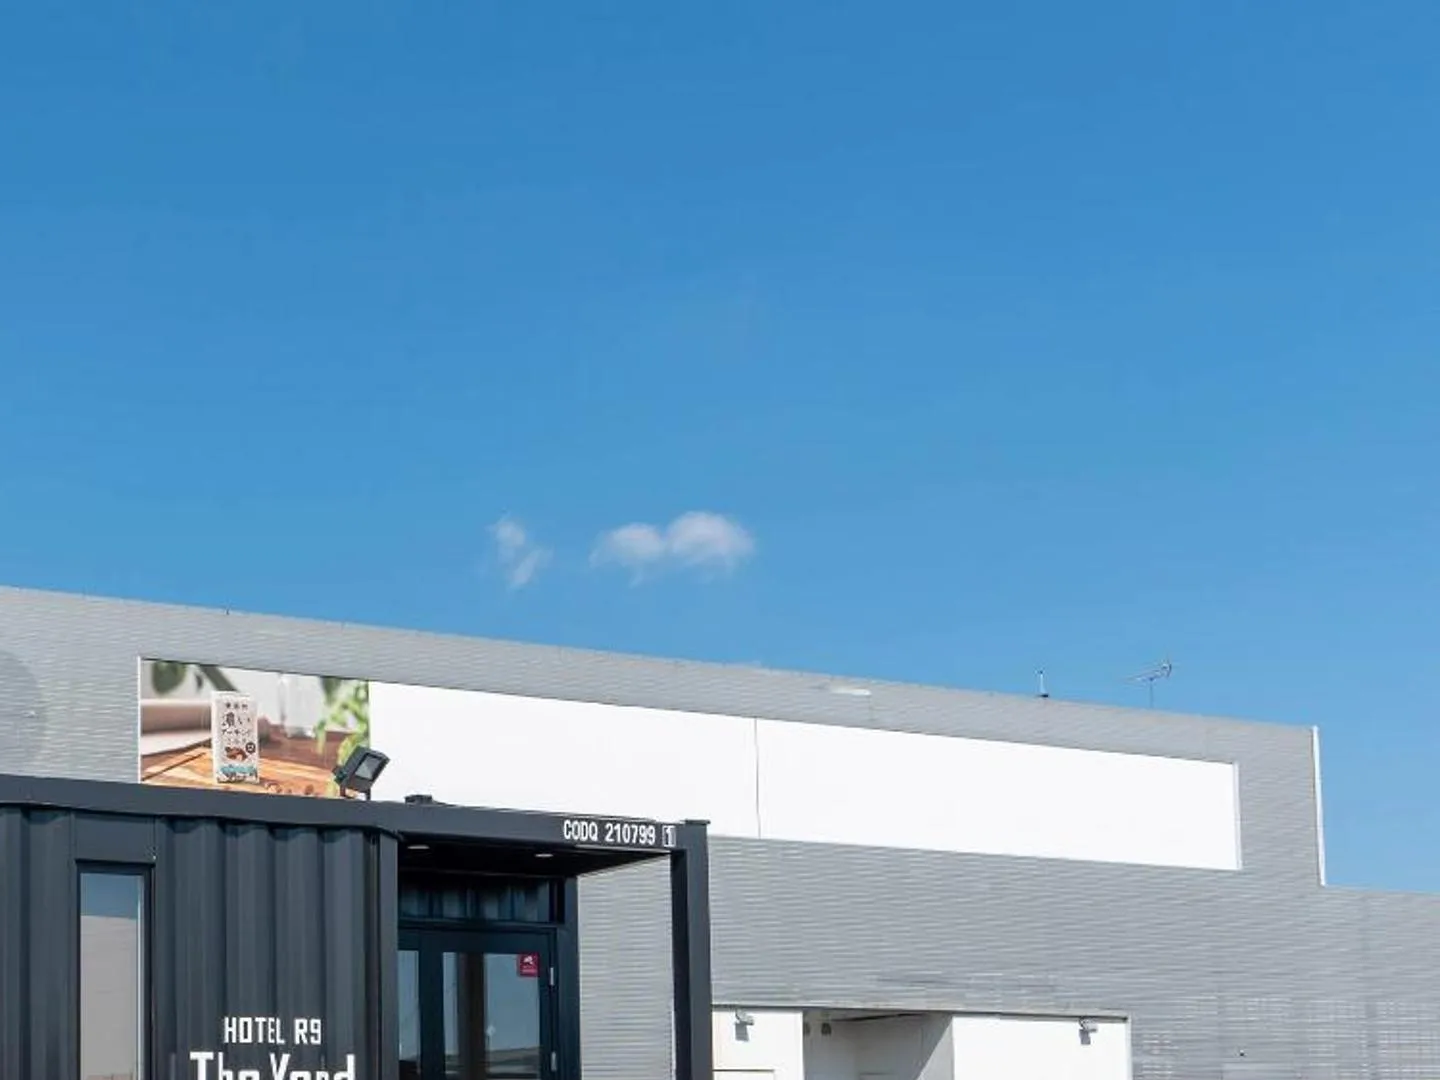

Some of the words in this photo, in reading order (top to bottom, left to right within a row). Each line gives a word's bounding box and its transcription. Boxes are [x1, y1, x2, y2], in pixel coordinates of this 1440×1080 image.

[605, 823, 656, 845] 210799
[224, 1016, 285, 1045] HOTEL
[294, 1018, 322, 1045] R9
